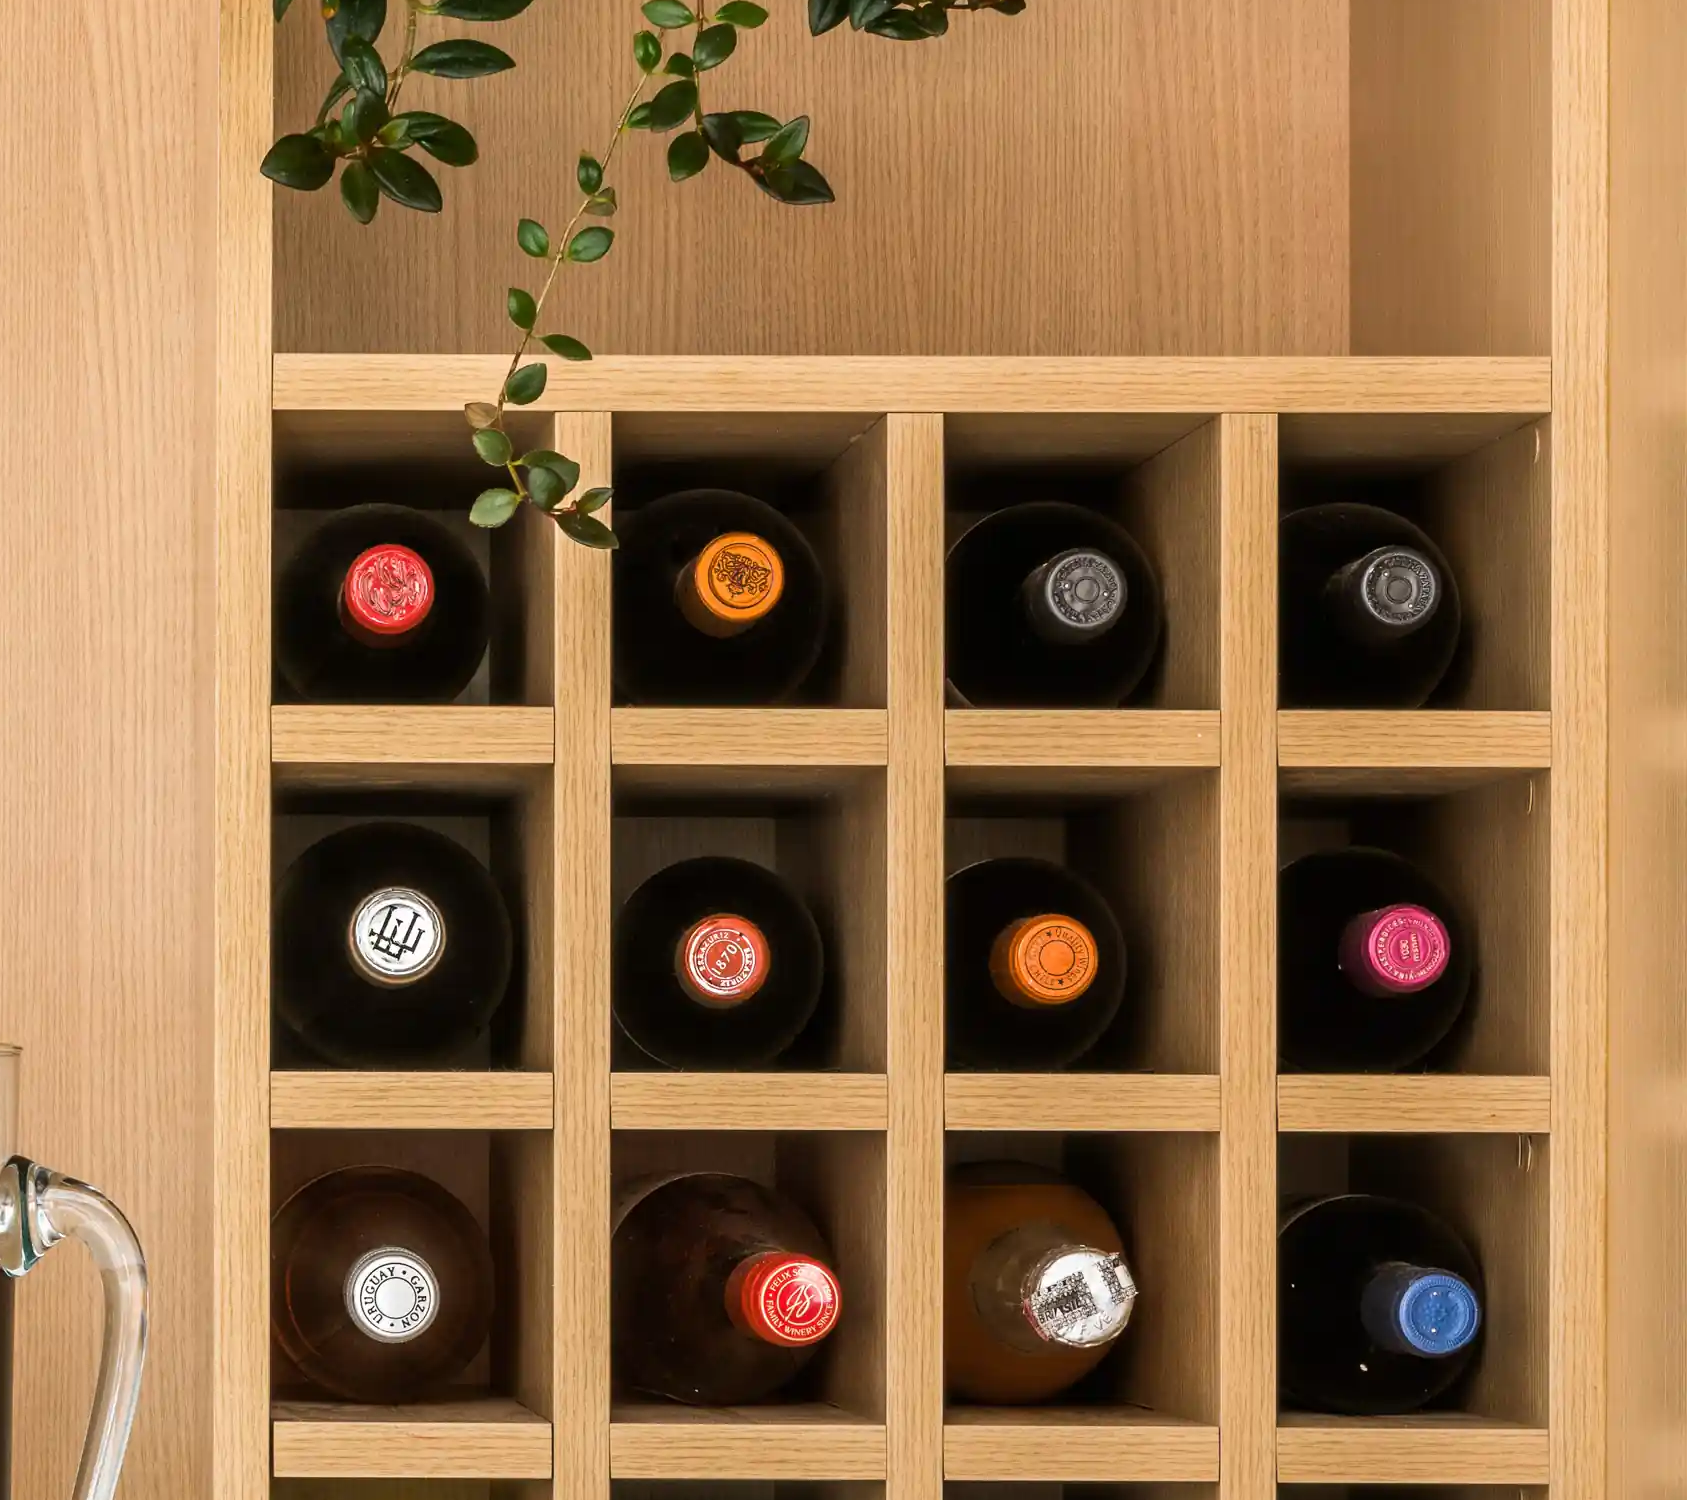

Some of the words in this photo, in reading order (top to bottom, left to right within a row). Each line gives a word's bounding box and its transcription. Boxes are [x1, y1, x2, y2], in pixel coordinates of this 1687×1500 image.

[711, 943, 739, 975] 1870
[364, 1266, 395, 1324] URUGUAY
[770, 1269, 792, 1292] FELIX
[402, 1275, 427, 1328] GARZON
[765, 1300, 785, 1329] FAMILY
[784, 1325, 818, 1337] WINERY
[816, 1302, 833, 1329] SINCE
